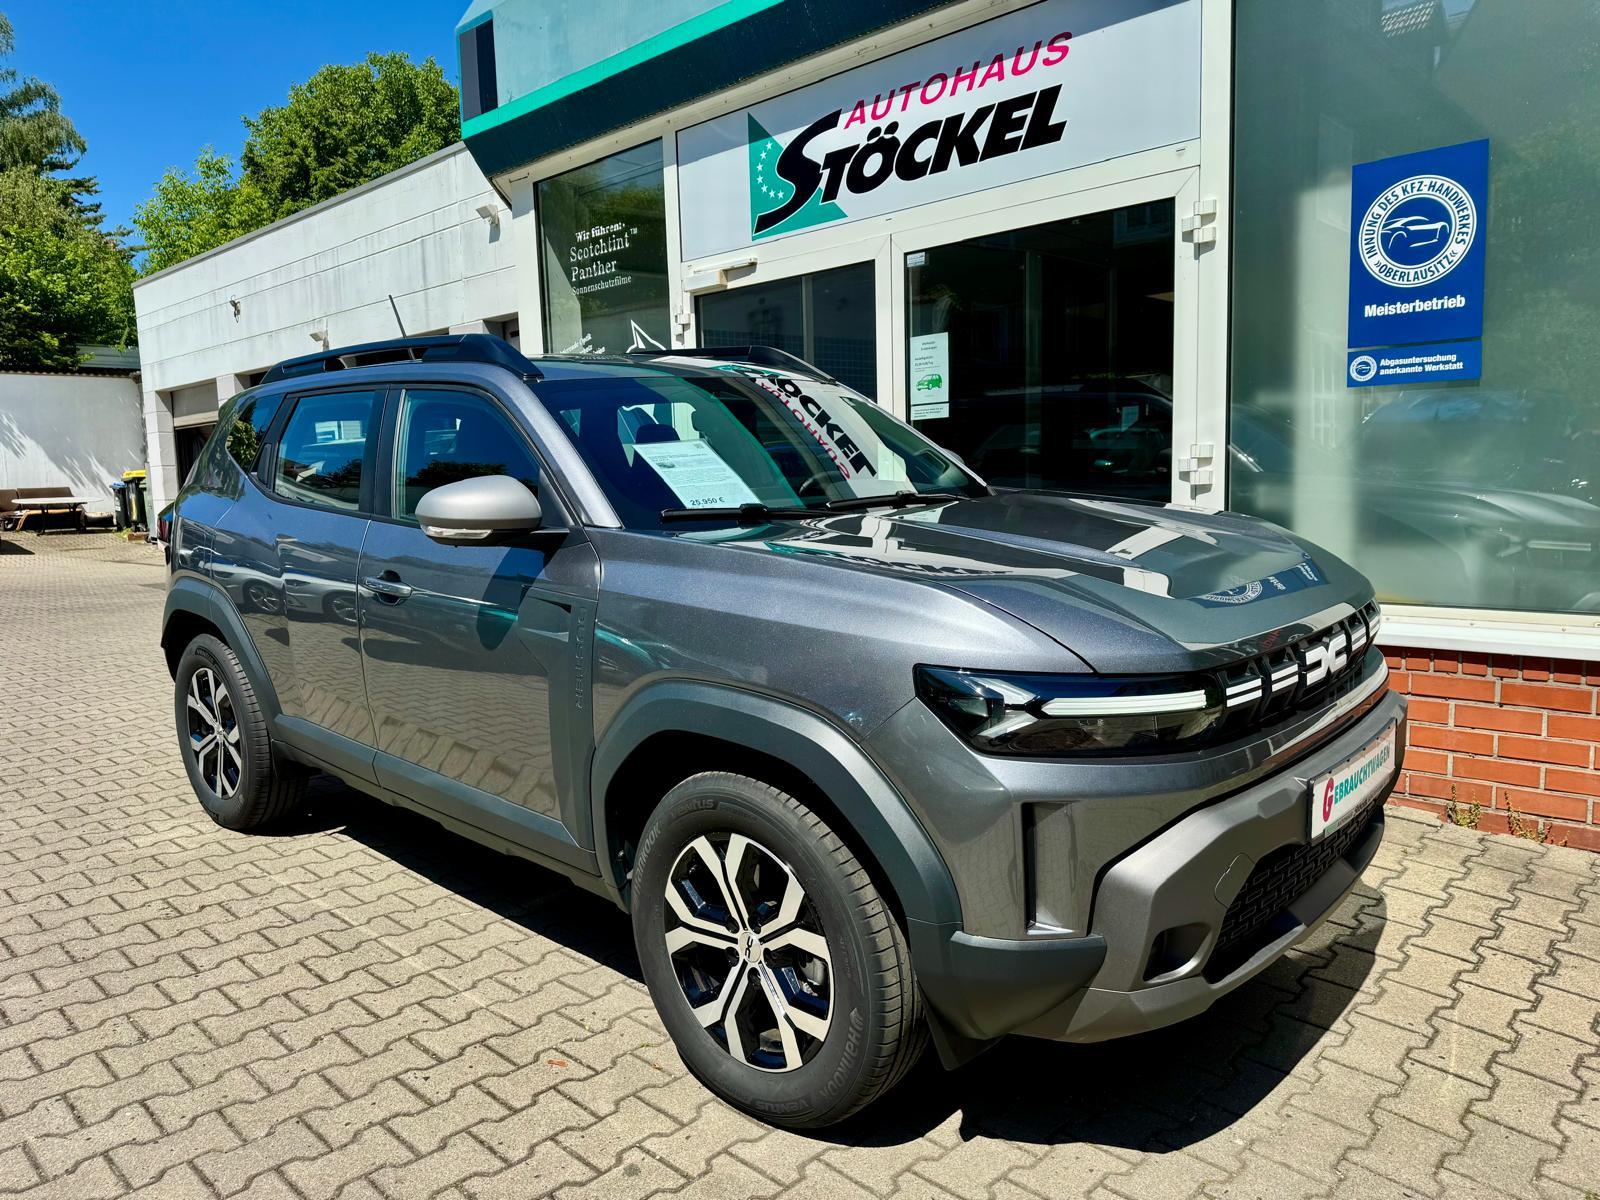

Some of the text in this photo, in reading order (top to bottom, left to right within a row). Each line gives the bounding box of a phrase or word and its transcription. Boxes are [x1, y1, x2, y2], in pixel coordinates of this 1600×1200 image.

[843, 31, 1073, 129] AUTOHAUS
[753, 83, 1068, 235] STÖCKEL
[1364, 180, 1471, 259] INNUNG DES KFZ-HANDWERKES
[575, 230, 590, 243] Wir
[571, 260, 617, 282] Panther
[572, 274, 632, 296] Sonnenschutzfilme
[1364, 294, 1466, 318] Meisterbetrieb
[1379, 353, 1457, 367] Abgasuntersuchung
[1379, 365, 1423, 376] anerkannte
[1424, 361, 1464, 372] Werkstatt
